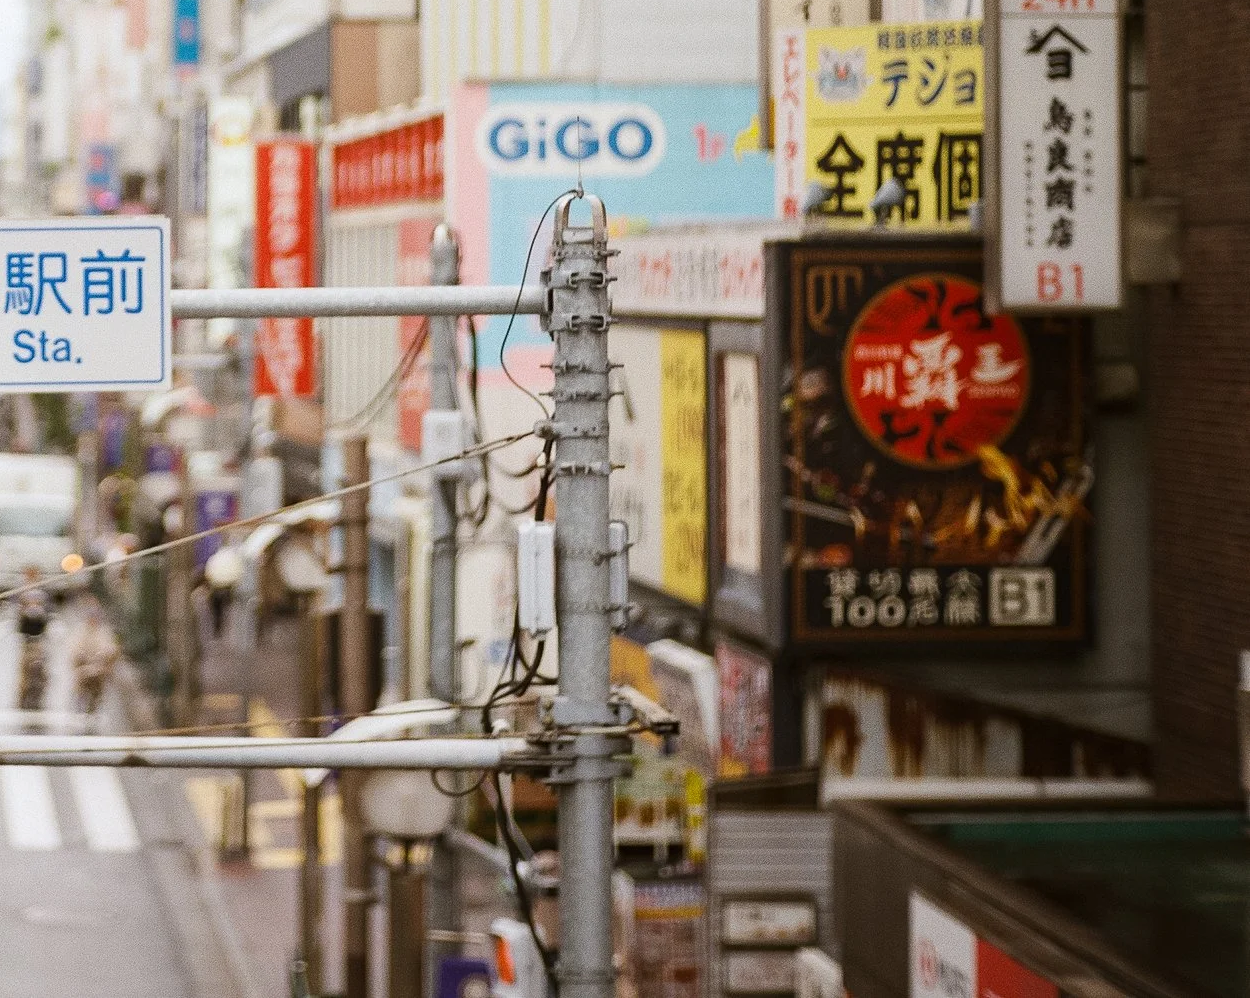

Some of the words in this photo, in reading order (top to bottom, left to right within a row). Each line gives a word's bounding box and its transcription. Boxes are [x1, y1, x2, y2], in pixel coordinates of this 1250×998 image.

[489, 116, 654, 163] GiGO
[1037, 261, 1086, 303] B1
[12, 329, 83, 365] Sta.
